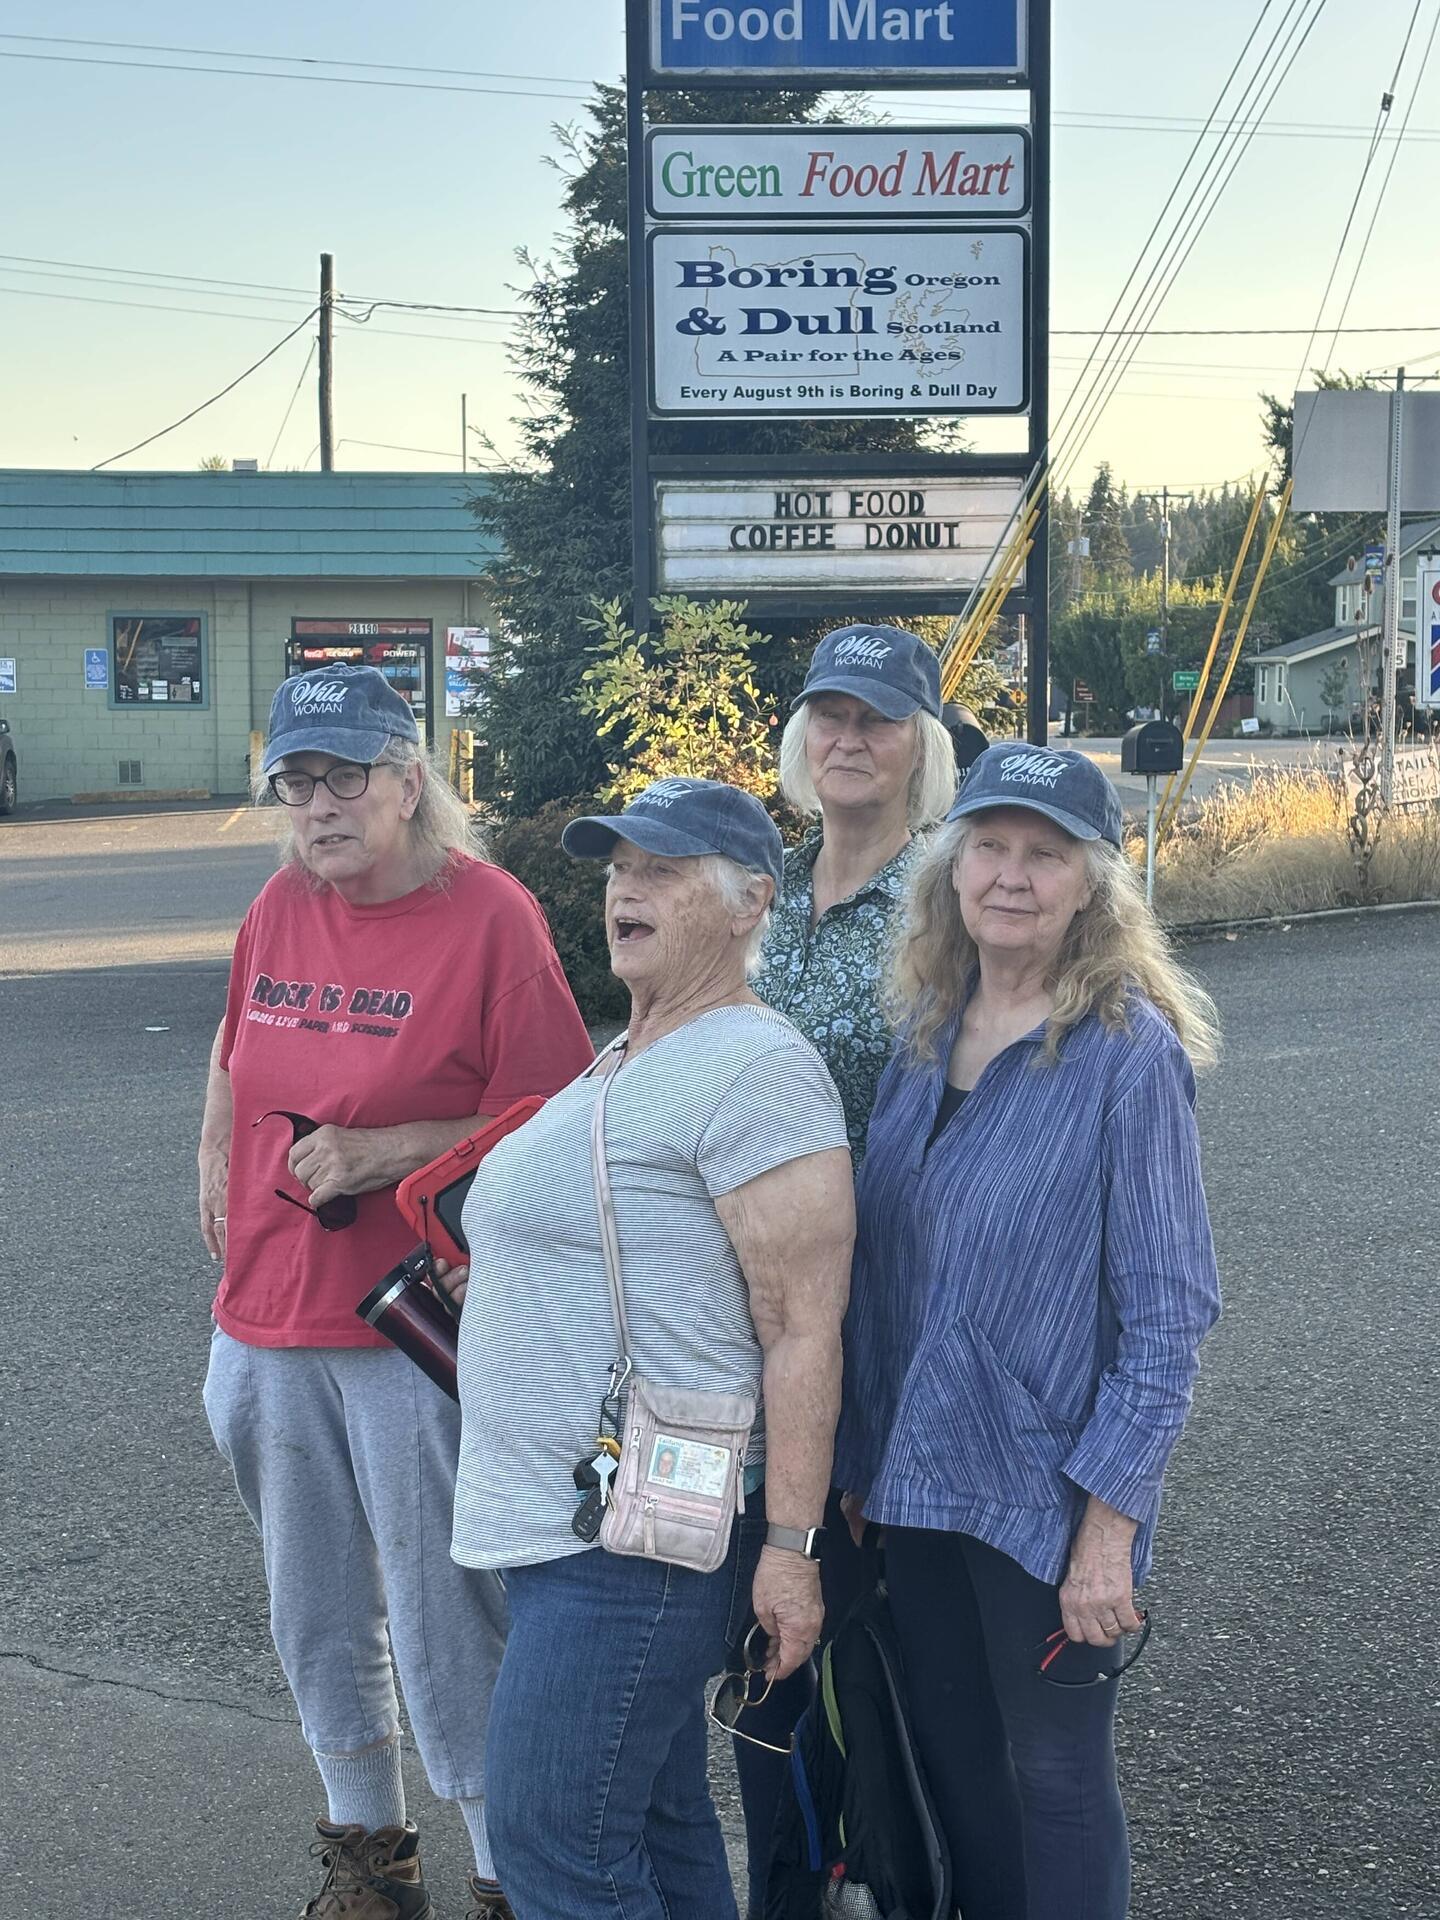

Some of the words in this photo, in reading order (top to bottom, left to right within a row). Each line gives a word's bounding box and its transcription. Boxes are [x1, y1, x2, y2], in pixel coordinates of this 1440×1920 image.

[671, 0, 803, 40] Food
[828, 0, 955, 41] Mart
[661, 151, 783, 197] Green
[798, 150, 907, 197] Food
[912, 151, 1014, 197] Mart
[674, 259, 897, 295] Boring
[905, 273, 1001, 289] Oregon
[675, 307, 727, 335] &
[738, 306, 879, 335] Dull
[887, 320, 1002, 335] Scotland
[717, 350, 739, 362] A
[743, 349, 803, 362] Pair
[808, 349, 848, 362] for
[852, 349, 894, 362] the
[897, 349, 961, 364] Ages
[680, 386, 728, 401] Every
[733, 385, 792, 401] August
[797, 385, 824, 399] 9th
[830, 385, 844, 399] is
[849, 385, 904, 401] Boring
[910, 384, 923, 398] &
[928, 384, 961, 398] Dull
[966, 384, 998, 400] Day
[775, 491, 832, 518] HOT
[849, 490, 925, 518] FOOD
[729, 524, 835, 551] COFFEE
[866, 522, 960, 549] DONUT
[350, 623, 378, 635] 28190
[834, 635, 893, 659] Wild
[834, 655, 884, 670] WOMAN
[291, 680, 349, 703] Wild
[294, 702, 343, 717] WOMAN
[1000, 753, 1068, 778] Wild
[1000, 772, 1058, 789] WOMAN
[251, 973, 316, 1012] ROCK
[318, 984, 345, 1014] IS
[348, 988, 413, 1020] DEAD
